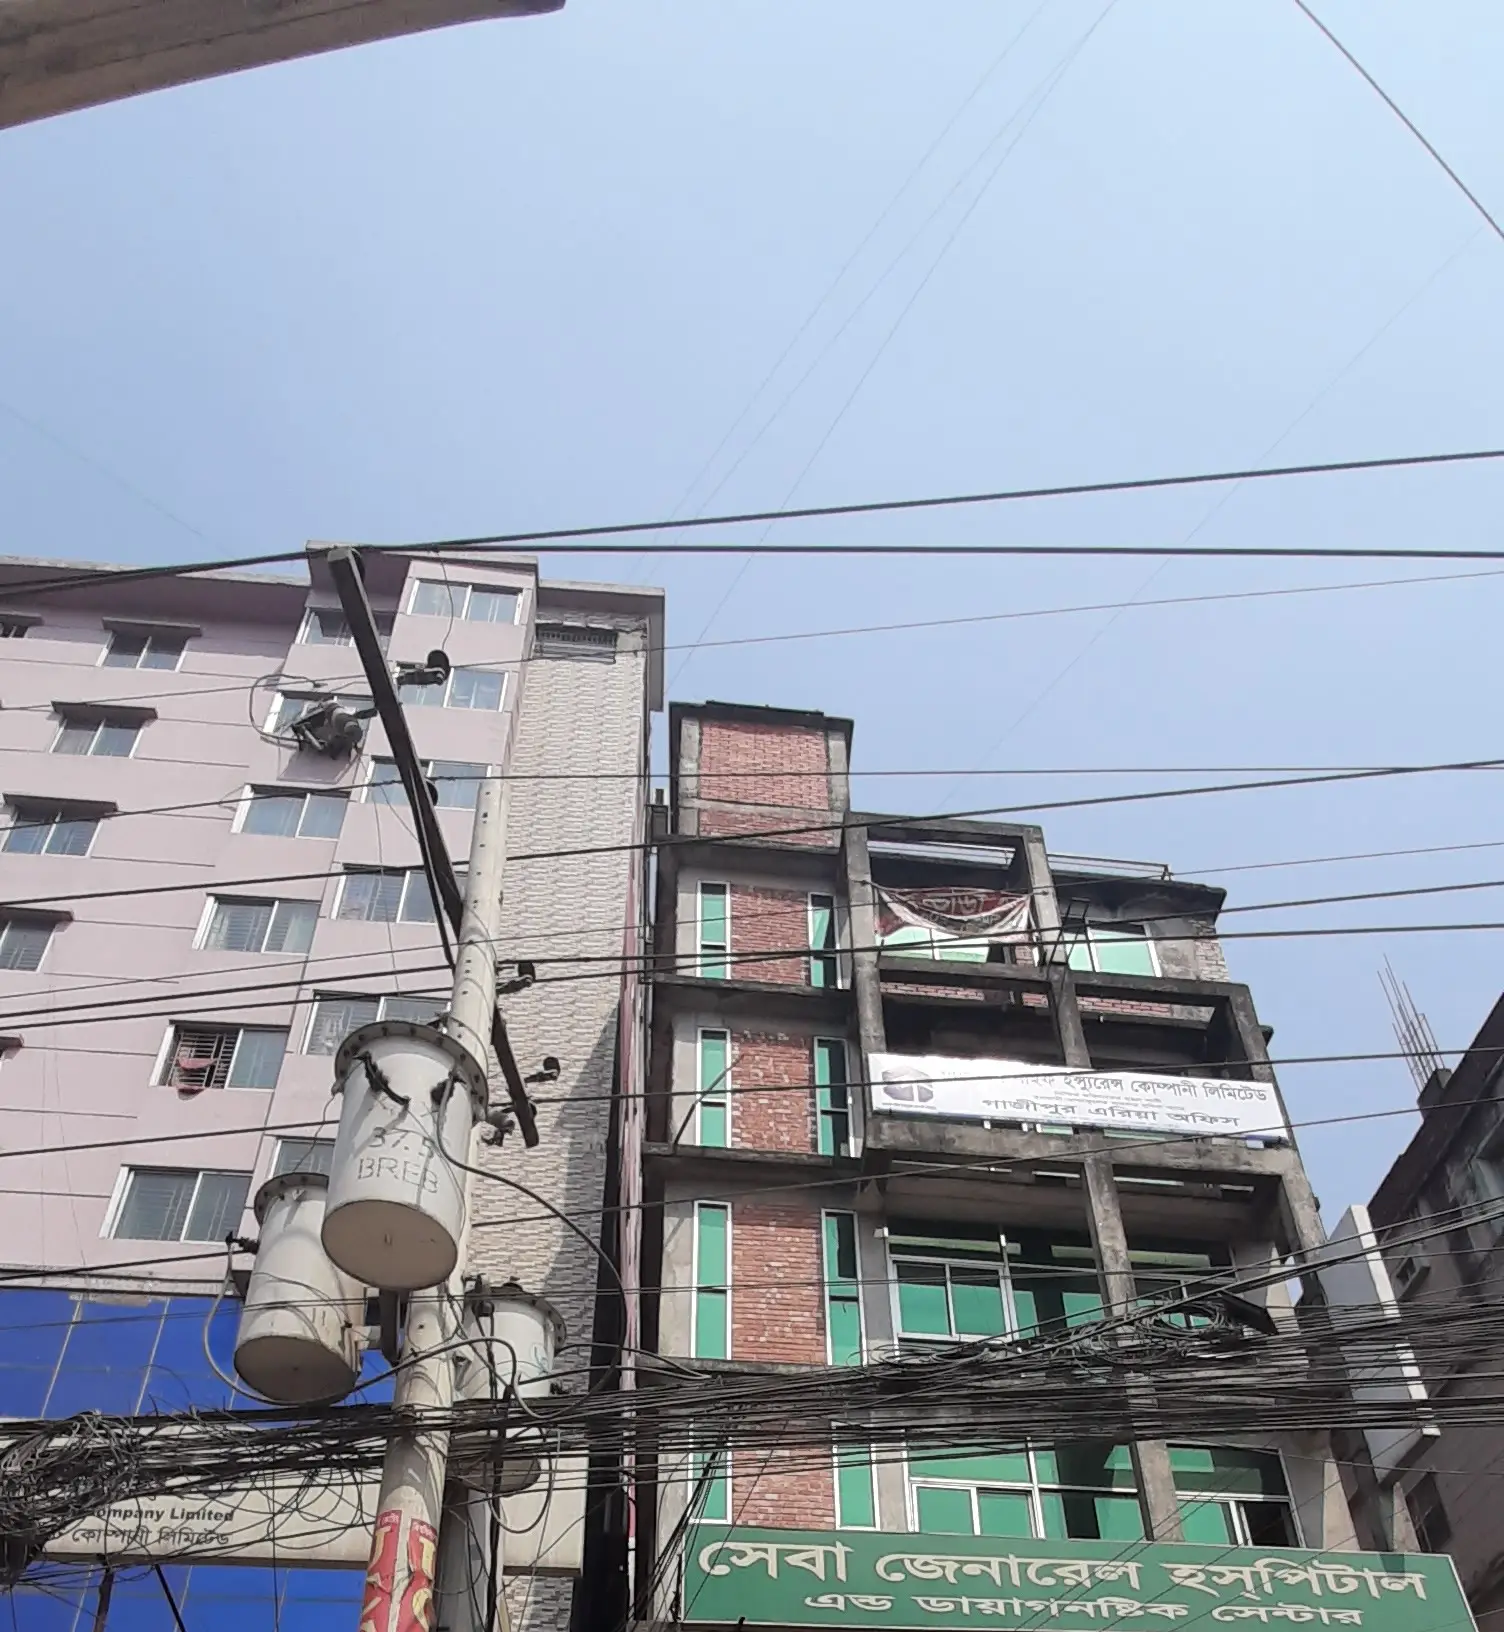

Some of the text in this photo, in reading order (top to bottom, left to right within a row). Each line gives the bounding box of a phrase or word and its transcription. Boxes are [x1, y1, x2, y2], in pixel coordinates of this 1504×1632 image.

[1203, 1081, 1268, 1102] লিমিটেড
[358, 1157, 438, 1194] BREB
[92, 1507, 234, 1522] ompany Limited
[699, 1541, 854, 1583] সেবা
[875, 1553, 1144, 1591] জেনারেল
[1210, 1602, 1364, 1627] সেন্টার
